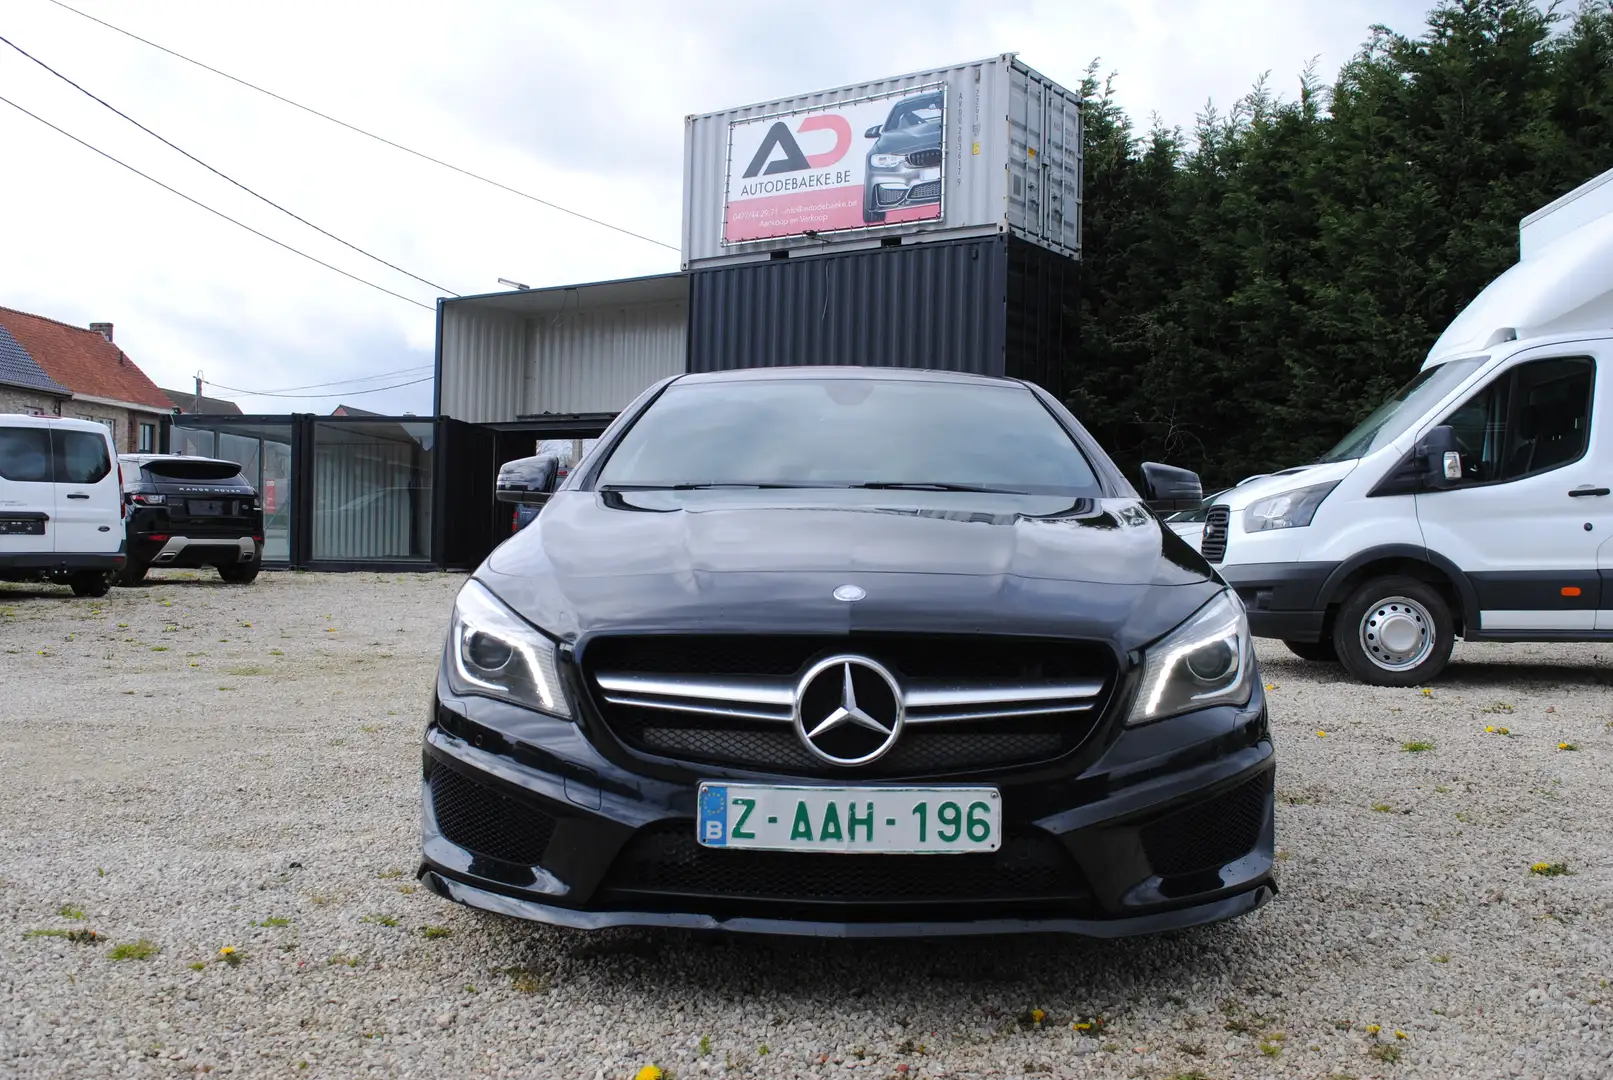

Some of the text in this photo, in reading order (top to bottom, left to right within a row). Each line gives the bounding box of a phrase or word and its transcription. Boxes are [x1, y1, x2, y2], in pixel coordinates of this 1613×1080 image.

[742, 114, 852, 179] AD
[740, 170, 851, 197] AUTODEBAEKE.BE
[705, 820, 723, 840] B
[731, 798, 991, 843] Z-AAH-196
